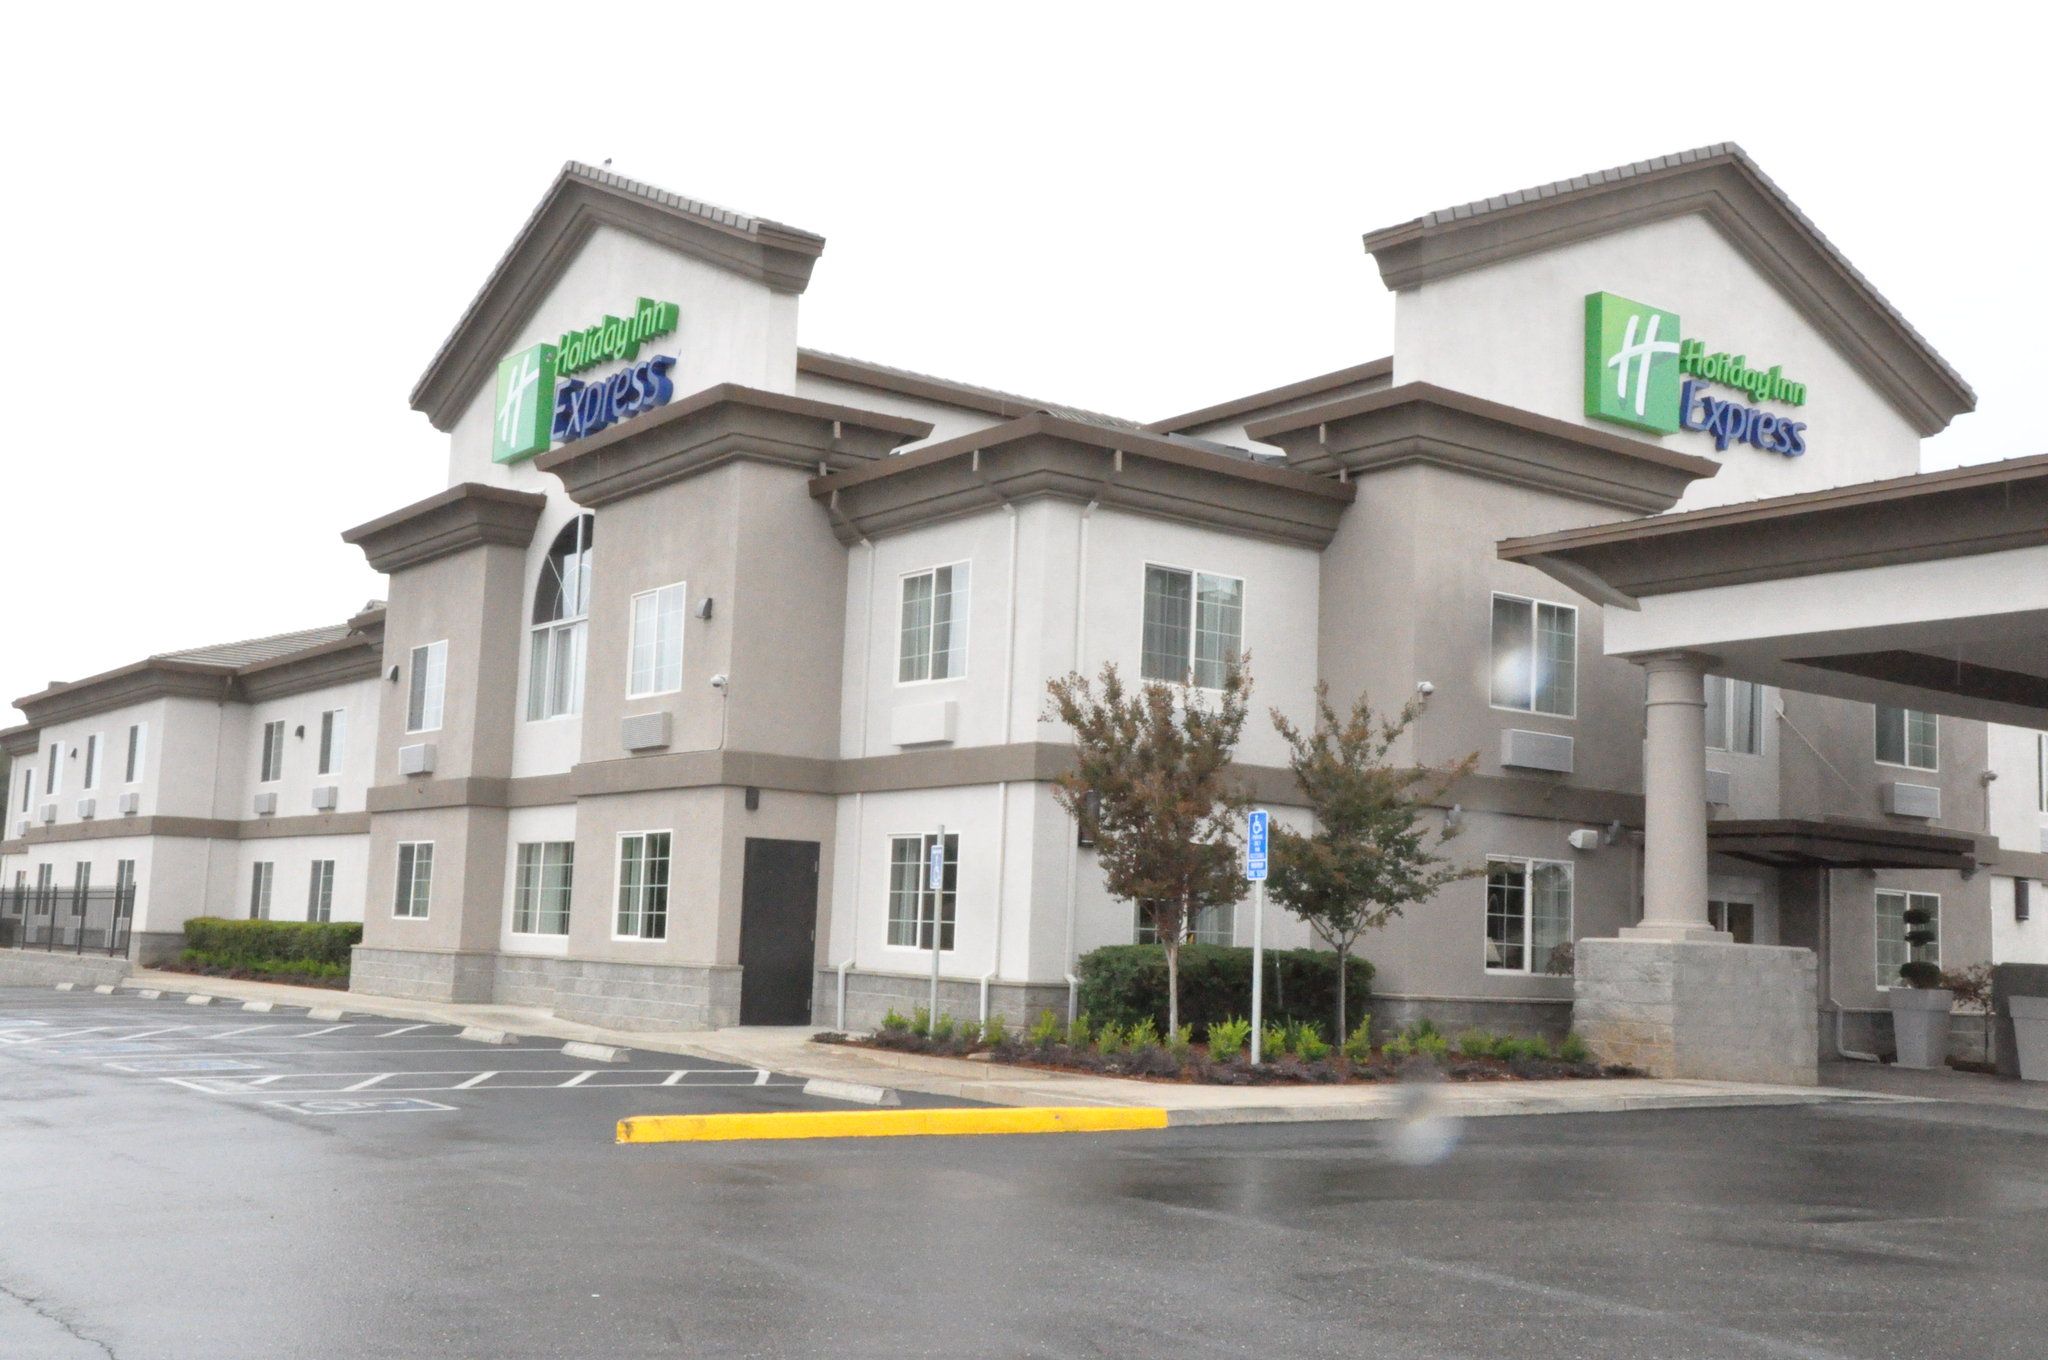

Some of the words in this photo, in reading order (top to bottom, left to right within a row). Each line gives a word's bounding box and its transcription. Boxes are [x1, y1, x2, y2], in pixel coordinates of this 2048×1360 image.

[554, 315, 636, 376] Holiday
[632, 297, 674, 342] Inn
[1681, 339, 1772, 400] Holiday
[1771, 365, 1807, 406] Inn
[551, 355, 676, 441] Express
[1681, 380, 1808, 457] Express
